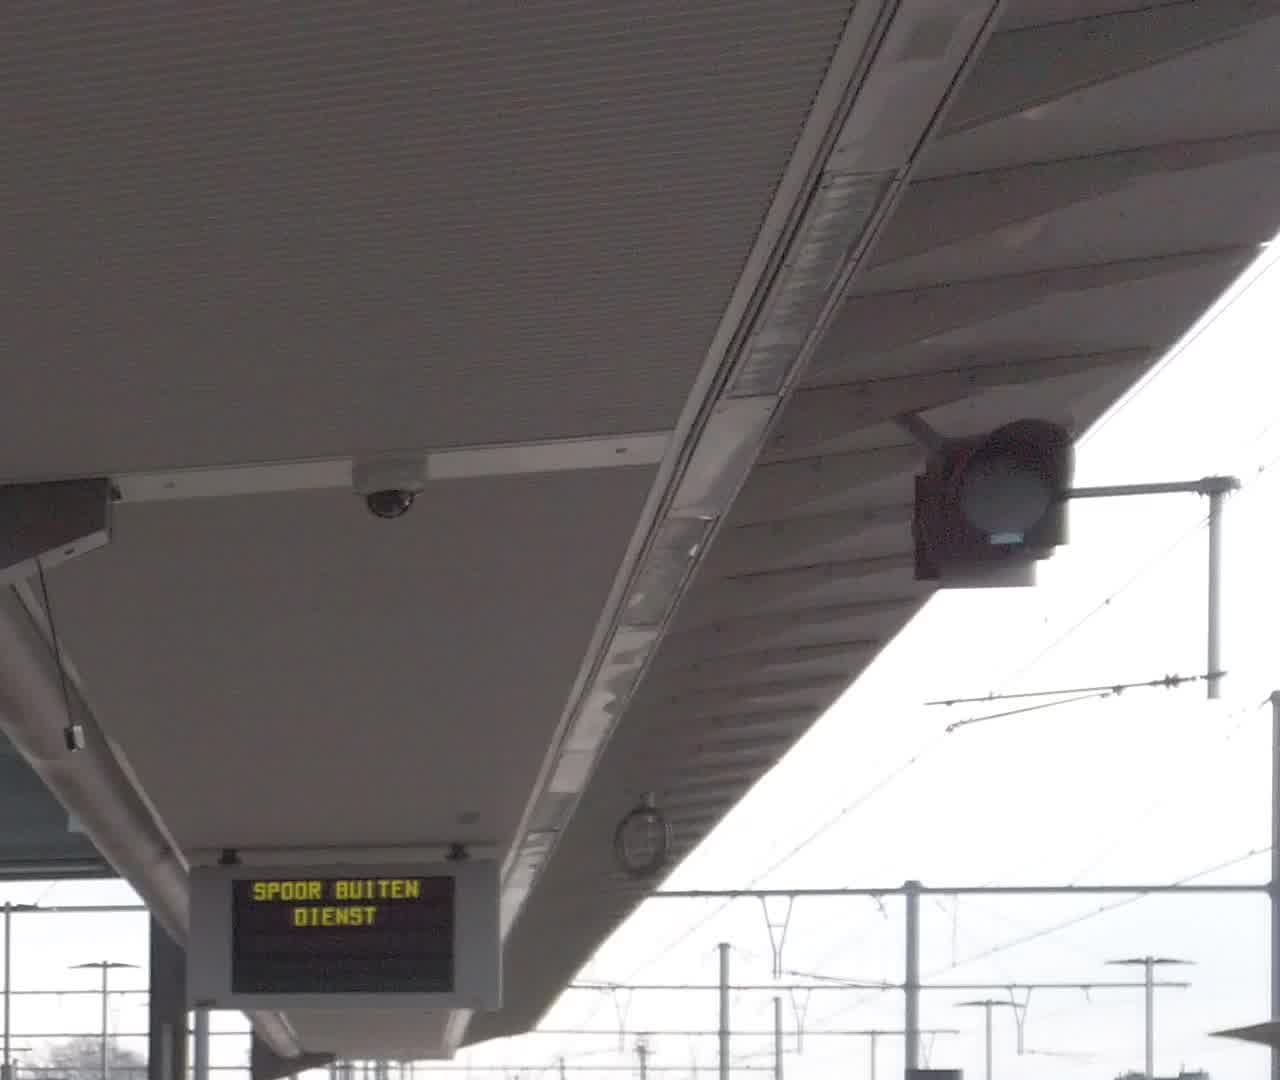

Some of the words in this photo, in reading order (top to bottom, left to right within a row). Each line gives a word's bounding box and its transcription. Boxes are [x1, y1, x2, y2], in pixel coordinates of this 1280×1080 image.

[253, 882, 322, 900] SPOOR
[336, 880, 419, 900] BUITEN
[294, 908, 377, 927] DIENST
